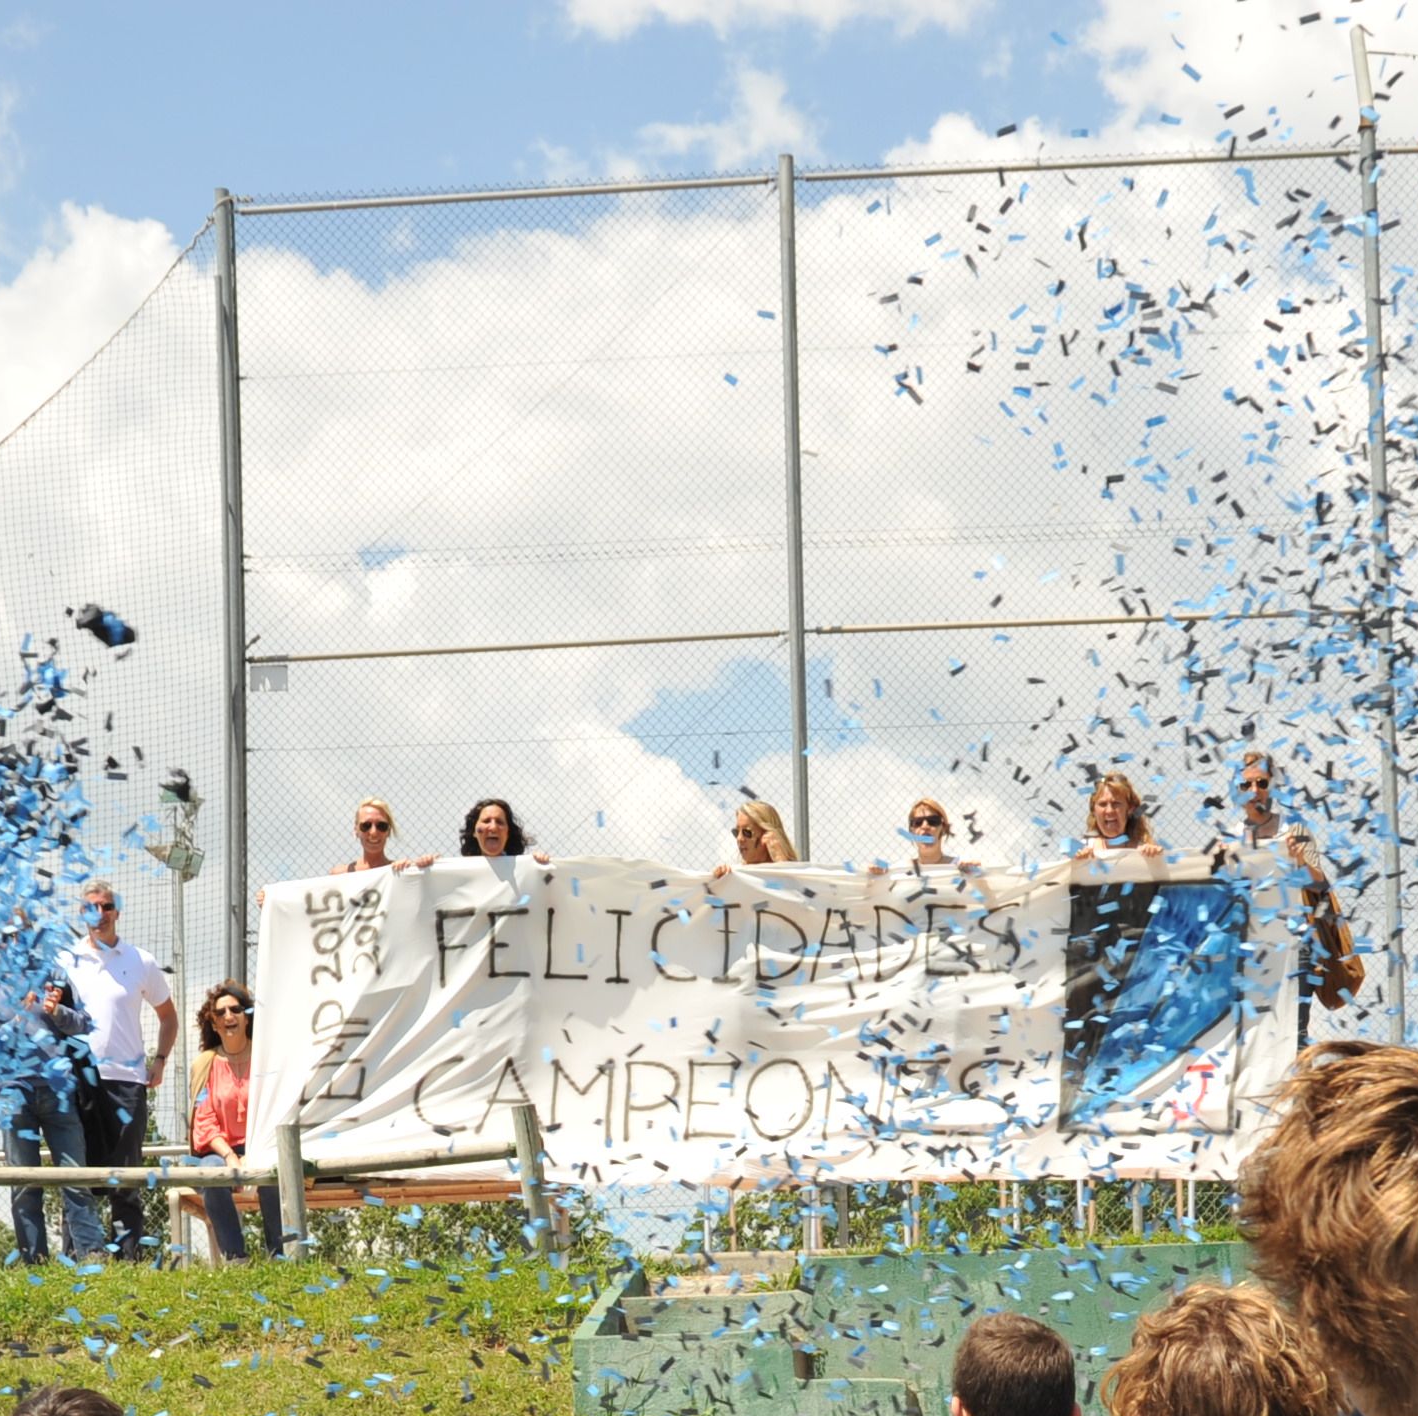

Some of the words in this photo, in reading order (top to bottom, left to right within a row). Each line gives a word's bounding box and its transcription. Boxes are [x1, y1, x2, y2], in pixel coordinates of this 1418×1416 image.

[305, 889, 344, 985] 2015
[436, 902, 1020, 988] FELICIDADES
[414, 1056, 1017, 1141] CAMPEONES
